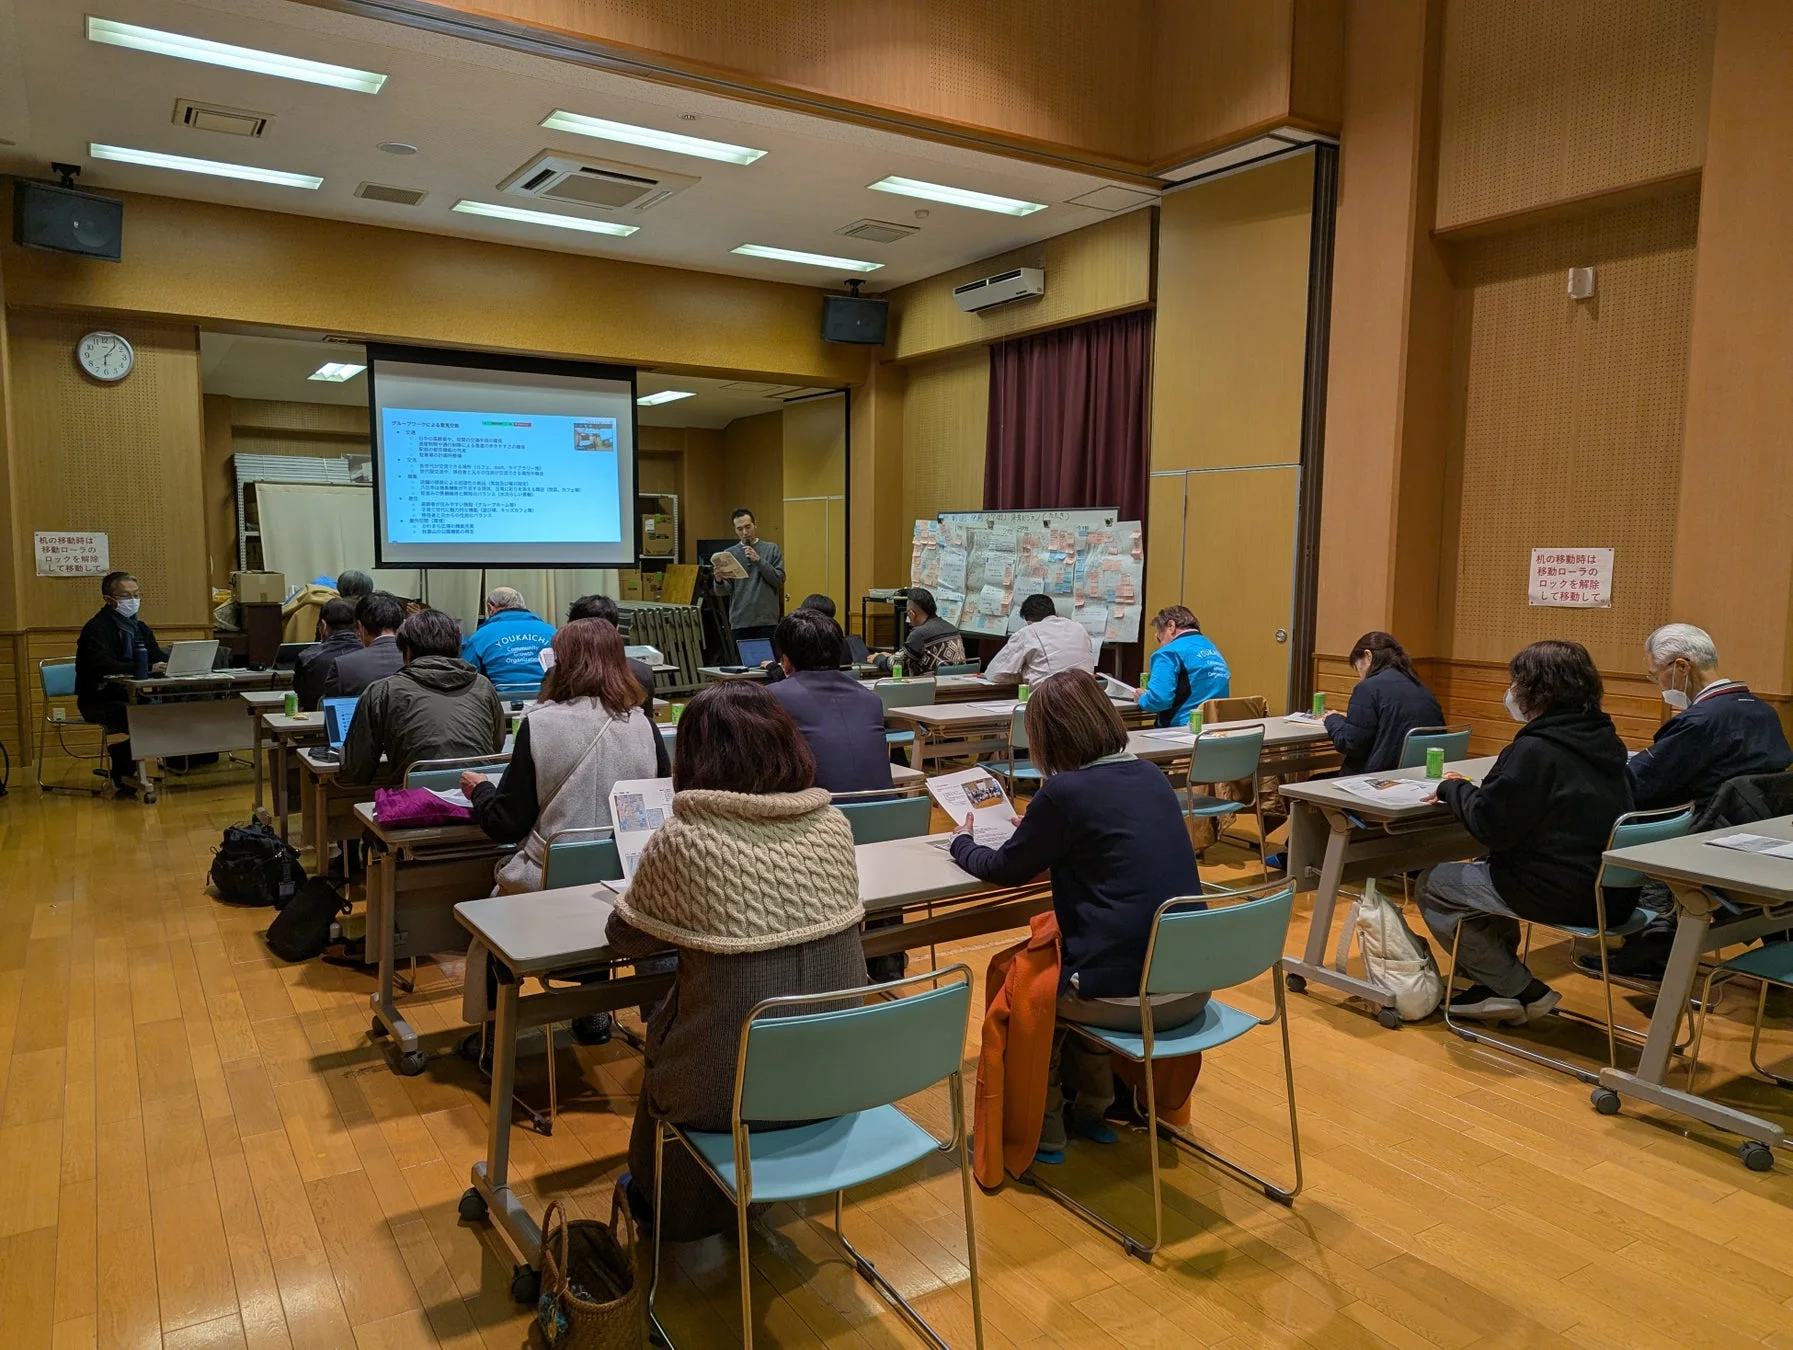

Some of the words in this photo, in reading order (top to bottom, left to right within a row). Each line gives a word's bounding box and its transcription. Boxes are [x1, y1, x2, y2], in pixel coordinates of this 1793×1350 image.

[39, 536, 94, 545] 机の移動時は
[41, 545, 97, 554] 移動ローラの
[45, 555, 99, 564] ロックを解除
[1536, 554, 1597, 565] 机の移動時は
[1537, 567, 1599, 577] 移動ローラの
[1539, 579, 1600, 590] ロックを解除
[496, 633, 549, 647] YOUKAICHI
